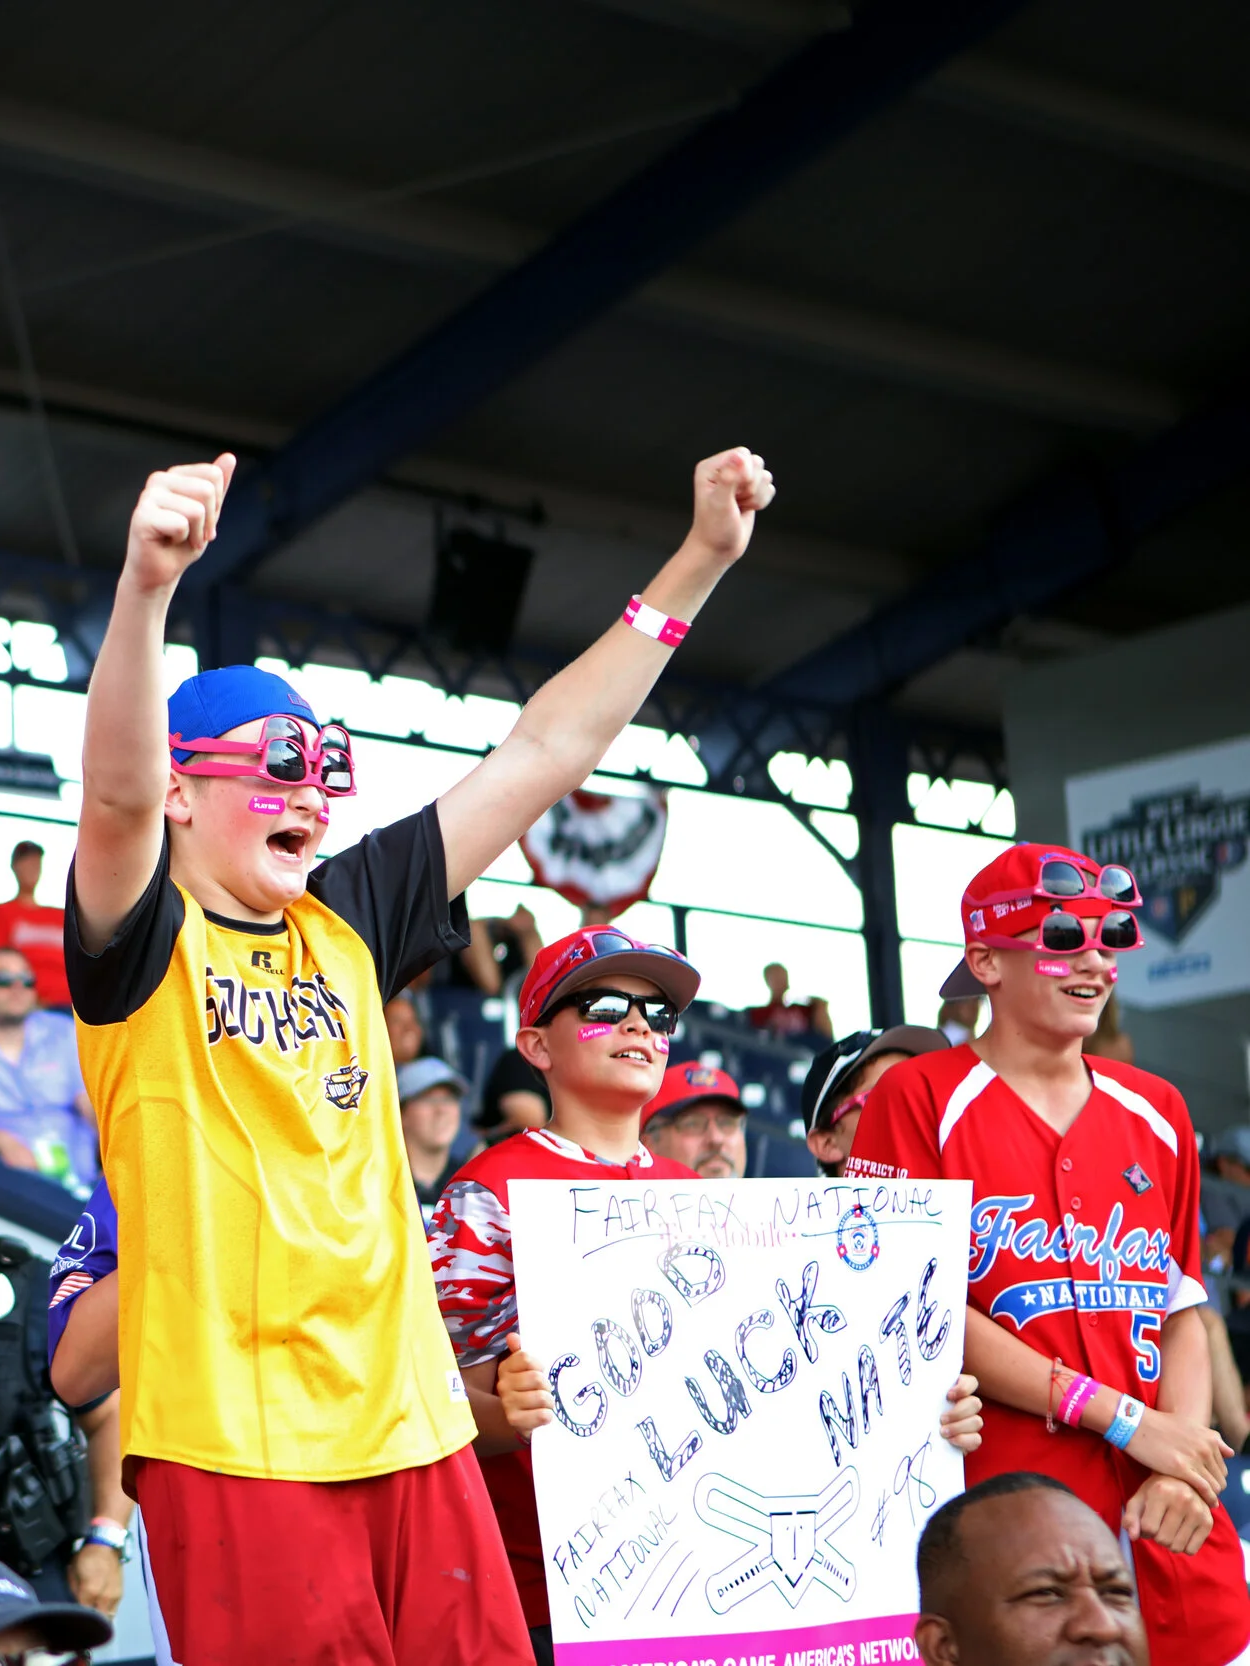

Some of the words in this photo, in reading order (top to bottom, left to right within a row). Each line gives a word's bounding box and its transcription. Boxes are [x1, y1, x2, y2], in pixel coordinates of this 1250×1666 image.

[570, 1187, 748, 1244] FAIRFAX
[773, 1186, 943, 1229] NATIONAL
[968, 1194, 1171, 1287] Fairfax
[547, 1240, 726, 1438] GOOD
[1038, 1283, 1156, 1309] NATIONAL
[1129, 1310, 1162, 1383] 5
[635, 1260, 848, 1482] LUCK
[819, 1257, 952, 1467] NATE
[553, 1470, 648, 1585] FAIRFAX
[573, 1502, 679, 1629] NATIONAL
